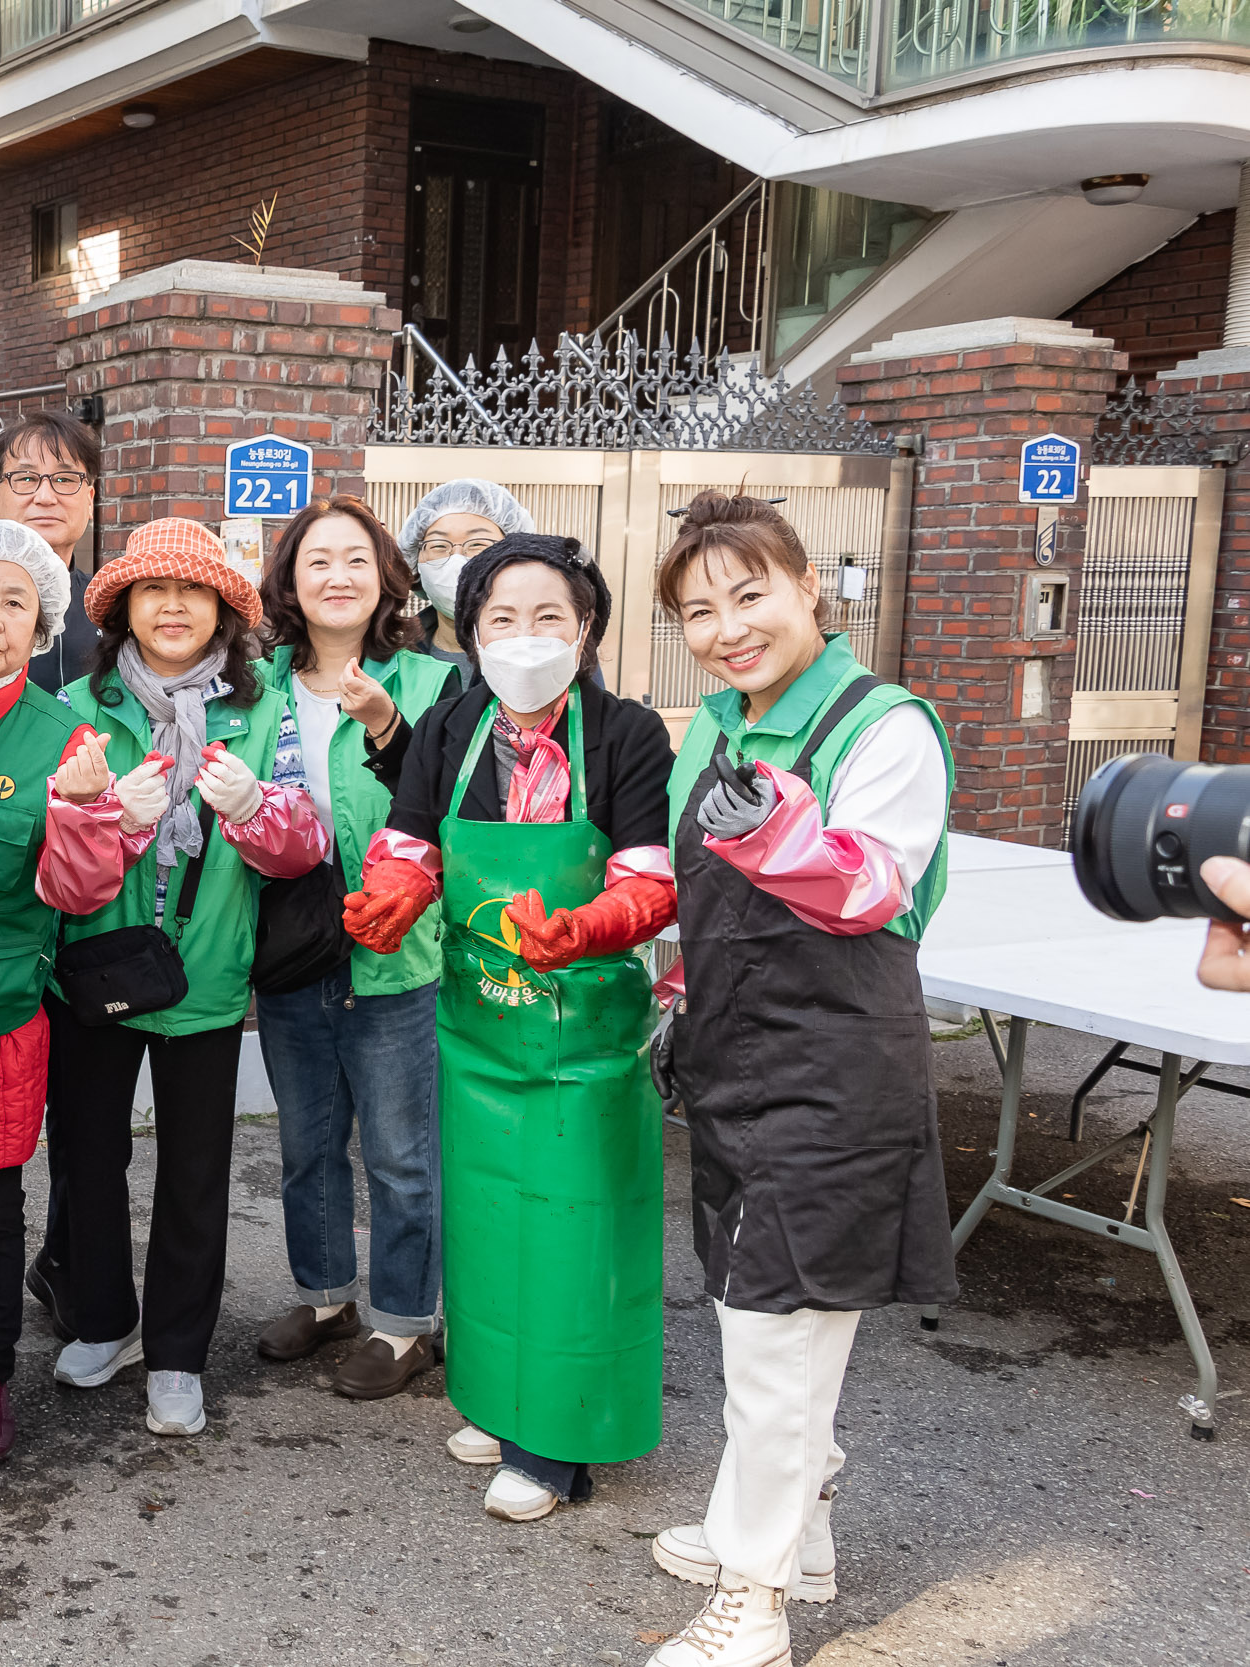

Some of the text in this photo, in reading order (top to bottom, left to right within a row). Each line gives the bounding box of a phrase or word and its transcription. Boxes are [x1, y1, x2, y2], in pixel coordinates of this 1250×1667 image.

[248, 448, 291, 460] 능동로30길
[240, 460, 298, 469] Neungdong-ro 30-gil
[1036, 470, 1061, 494] 22
[235, 478, 298, 508] 22-1
